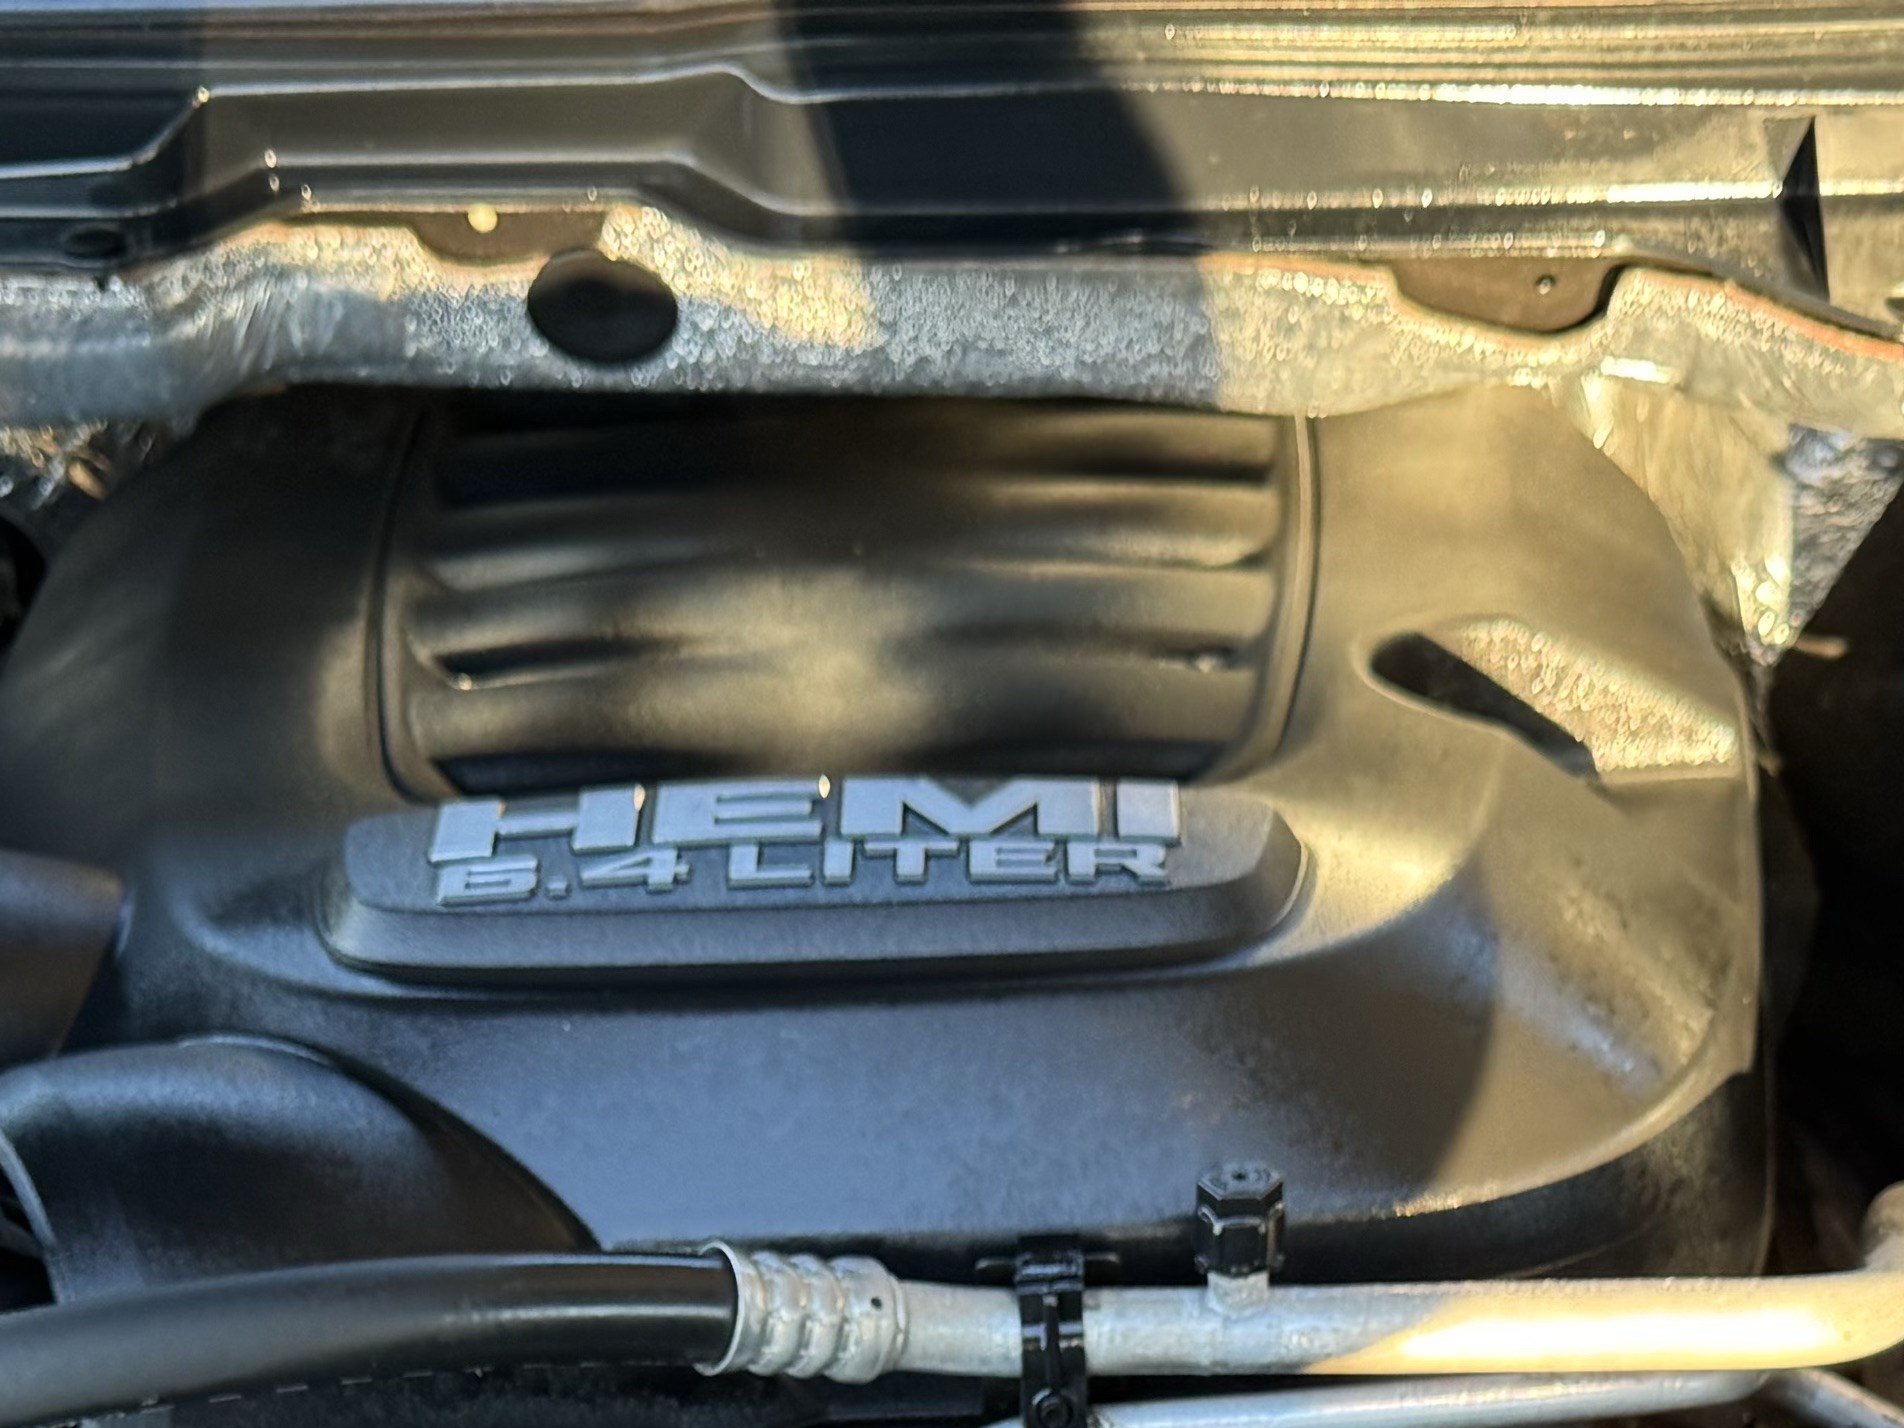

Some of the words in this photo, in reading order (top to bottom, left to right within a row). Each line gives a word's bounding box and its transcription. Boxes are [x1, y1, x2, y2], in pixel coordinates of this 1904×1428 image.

[427, 777, 1182, 862] HEMI
[435, 847, 690, 905] 6.4
[727, 838, 1170, 887] LITER
